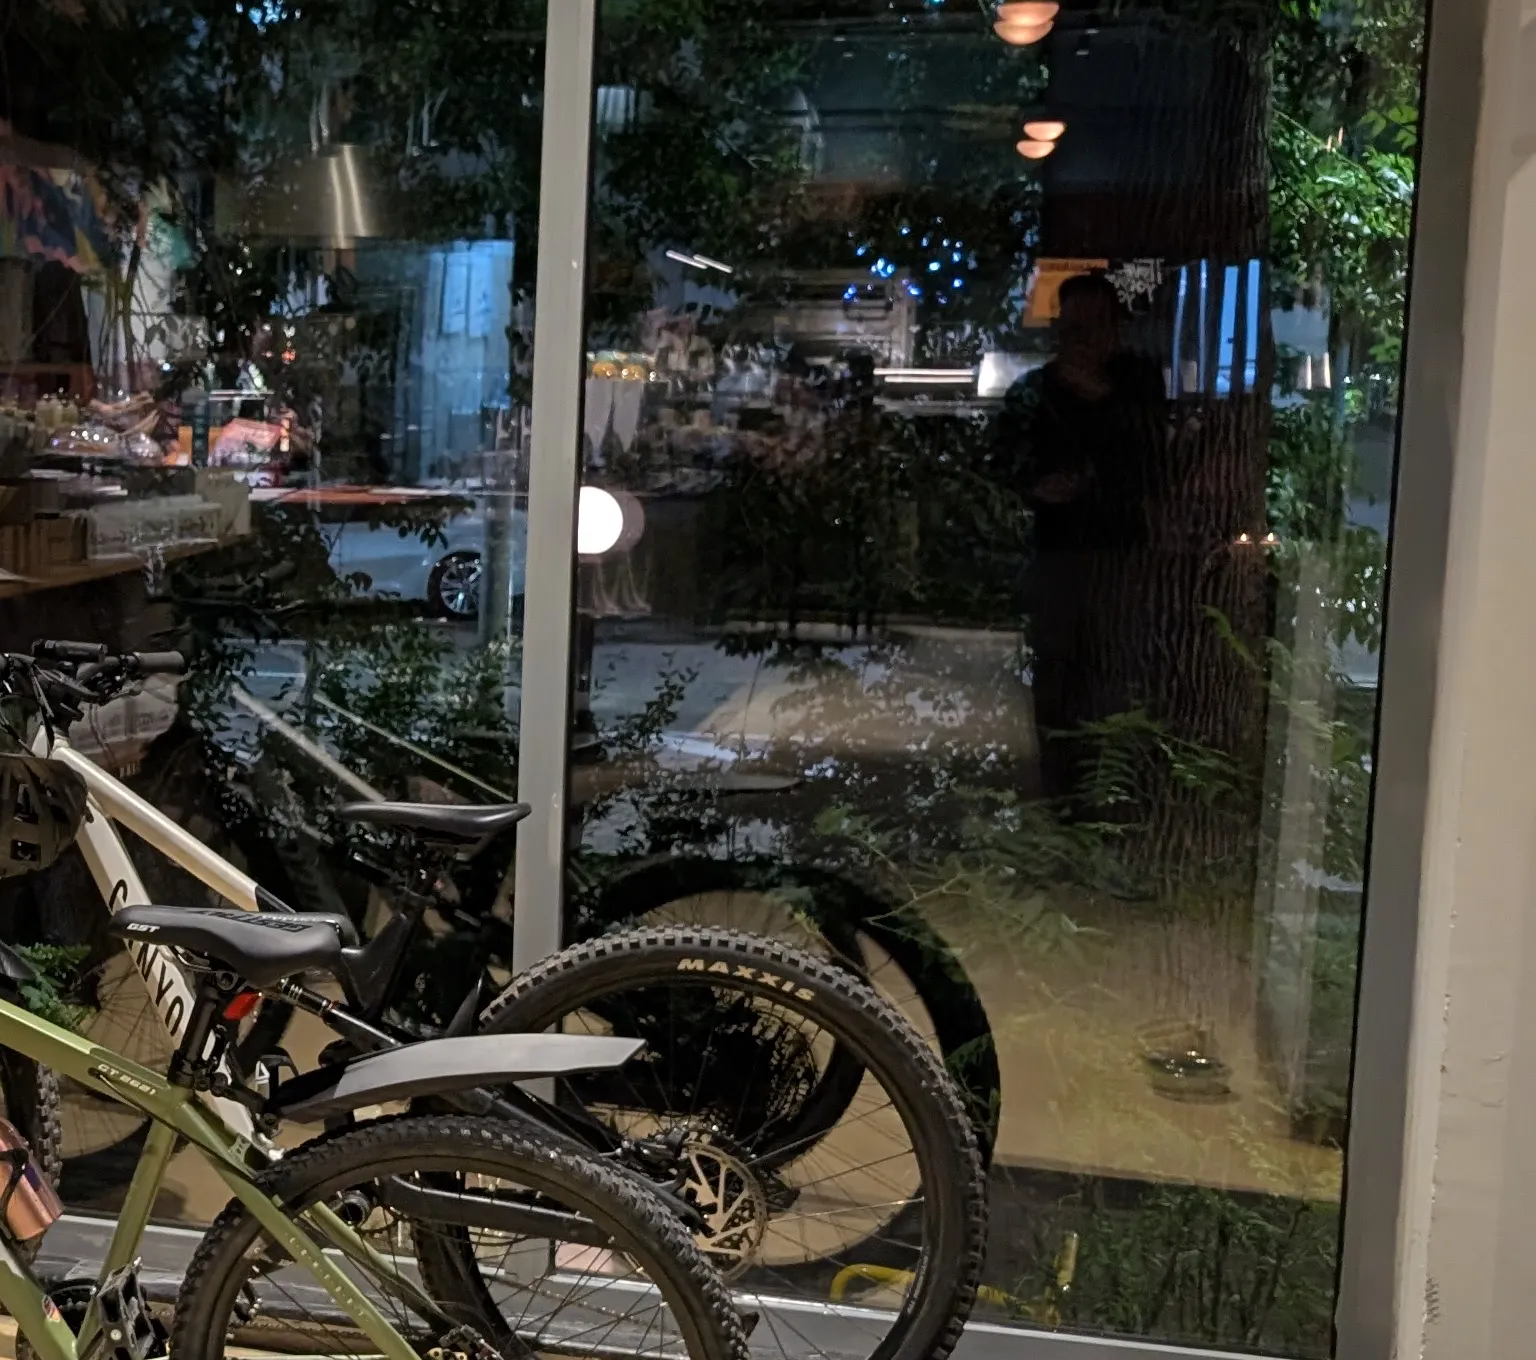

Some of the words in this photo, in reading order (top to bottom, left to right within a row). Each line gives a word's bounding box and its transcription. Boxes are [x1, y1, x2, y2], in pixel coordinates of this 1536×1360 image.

[126, 922, 161, 933] GST
[108, 879, 185, 1037] CNYO
[676, 958, 815, 1001] MAXXIS
